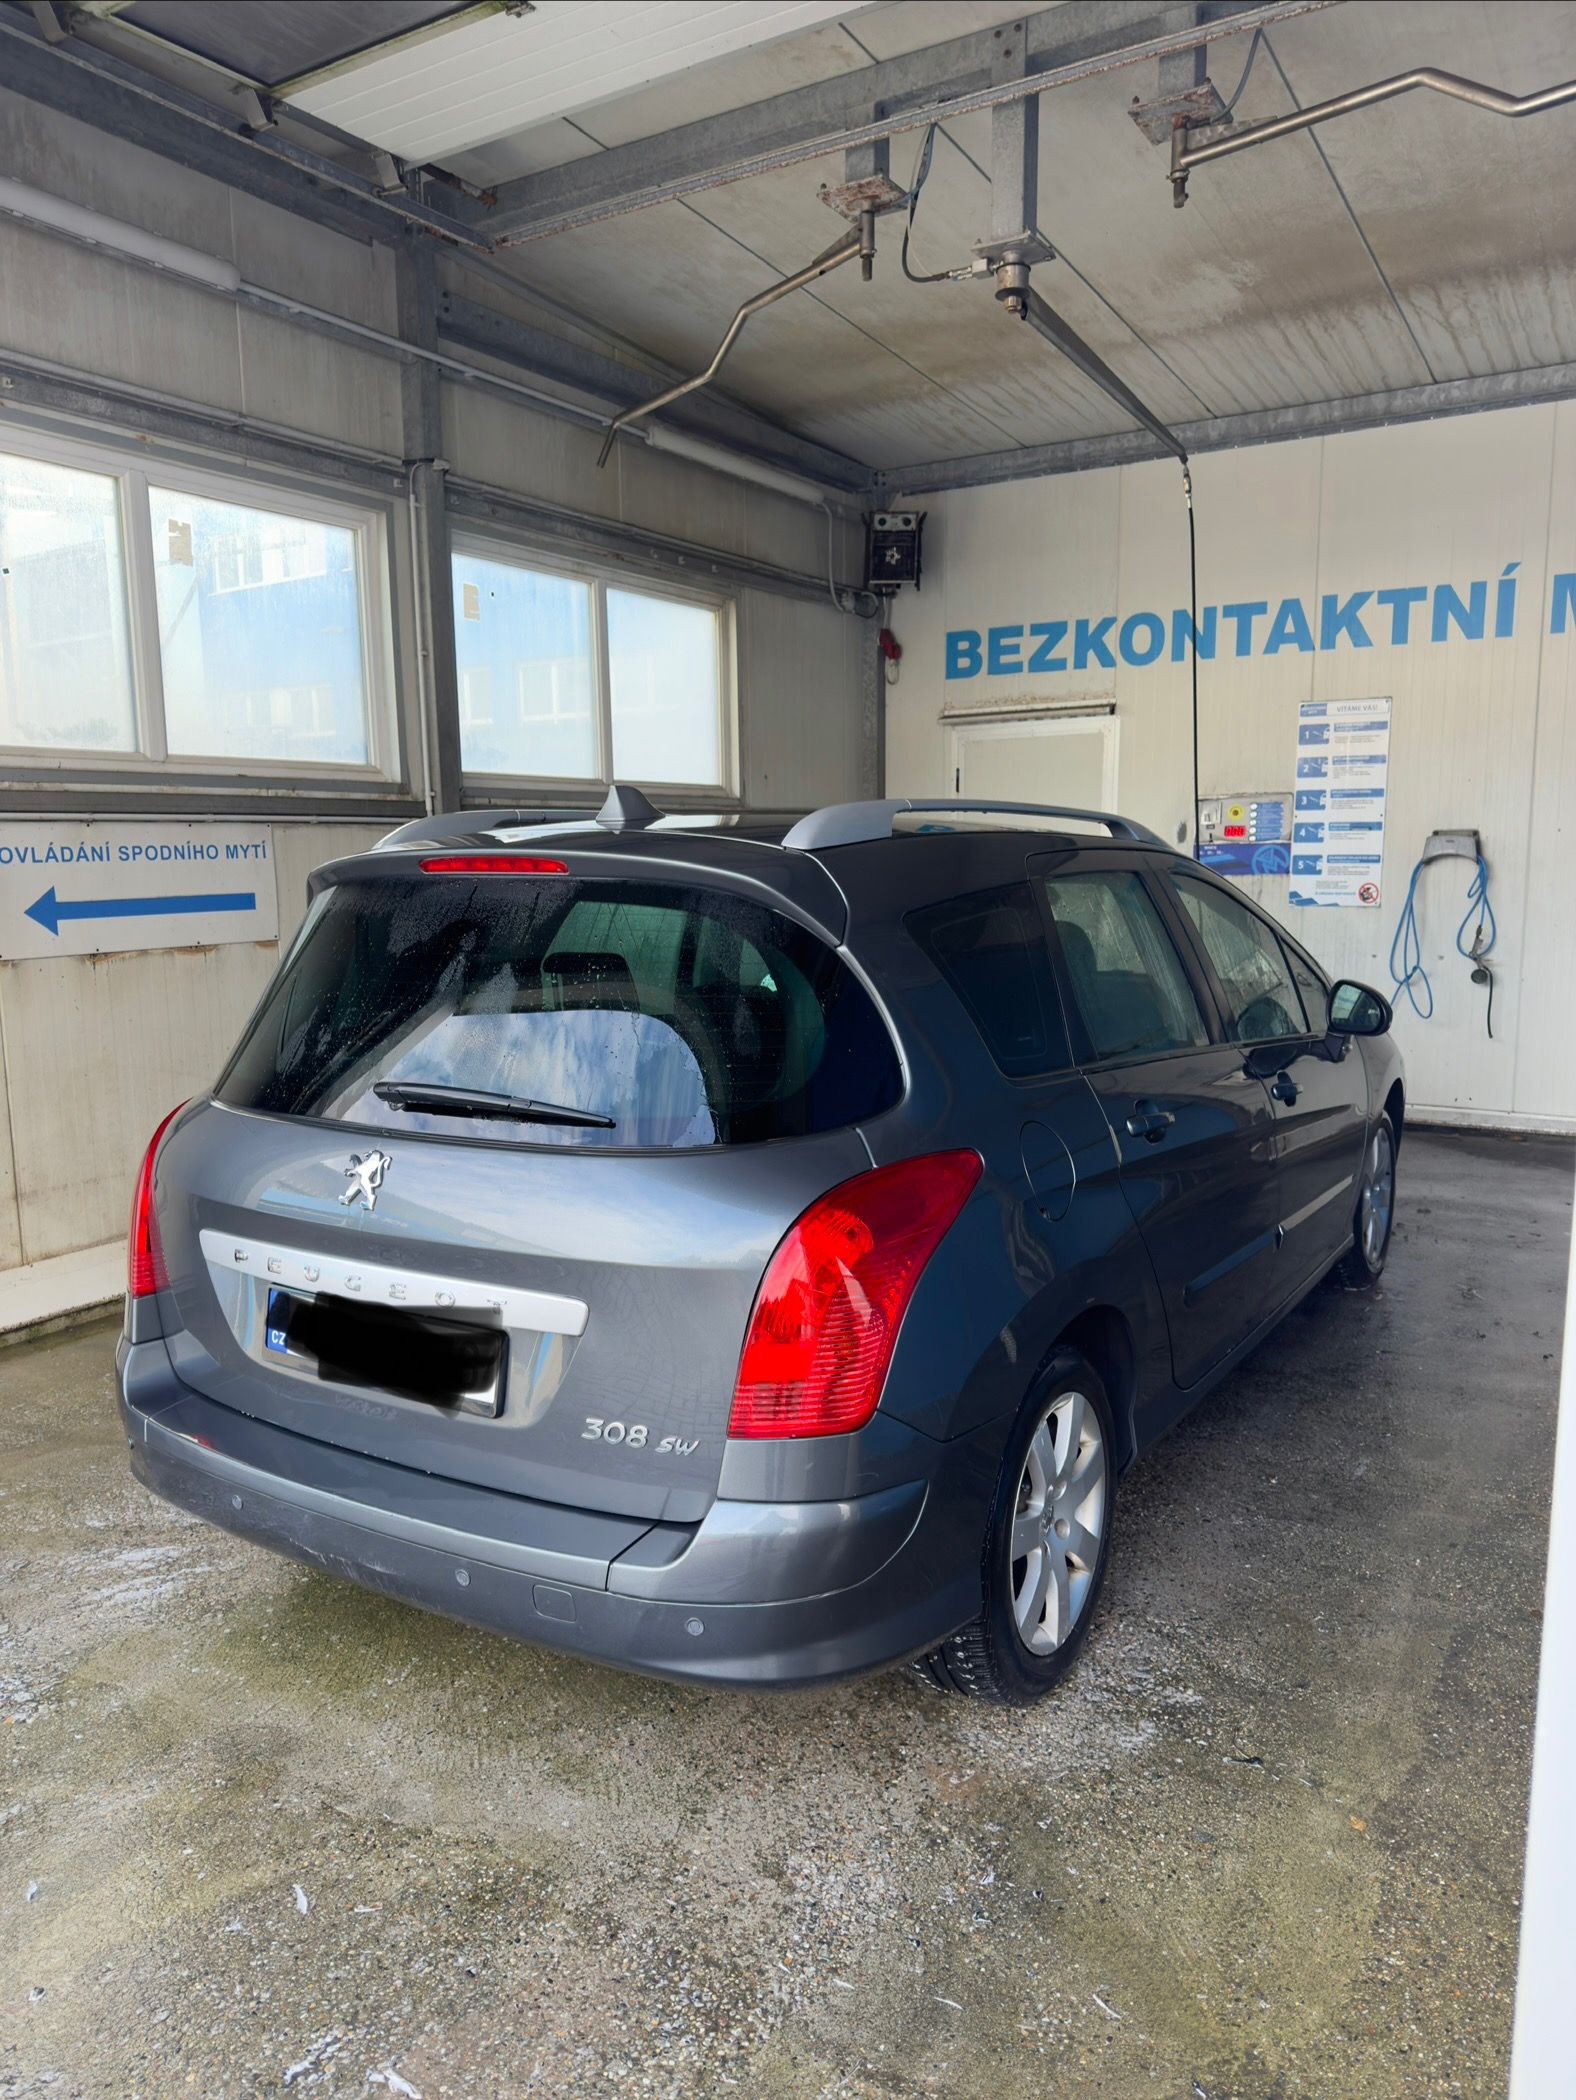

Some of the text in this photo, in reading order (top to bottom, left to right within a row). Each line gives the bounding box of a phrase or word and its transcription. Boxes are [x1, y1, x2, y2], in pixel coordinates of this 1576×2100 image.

[945, 562, 1521, 682] BEZKONTAKTNÍ
[0, 840, 267, 864] OVLÁDÁNÍ SPODNÍHO MYTÍ
[234, 1248, 508, 1316] PEUGEOT
[271, 1329, 287, 1346] CZ
[581, 1417, 649, 1449] 308
